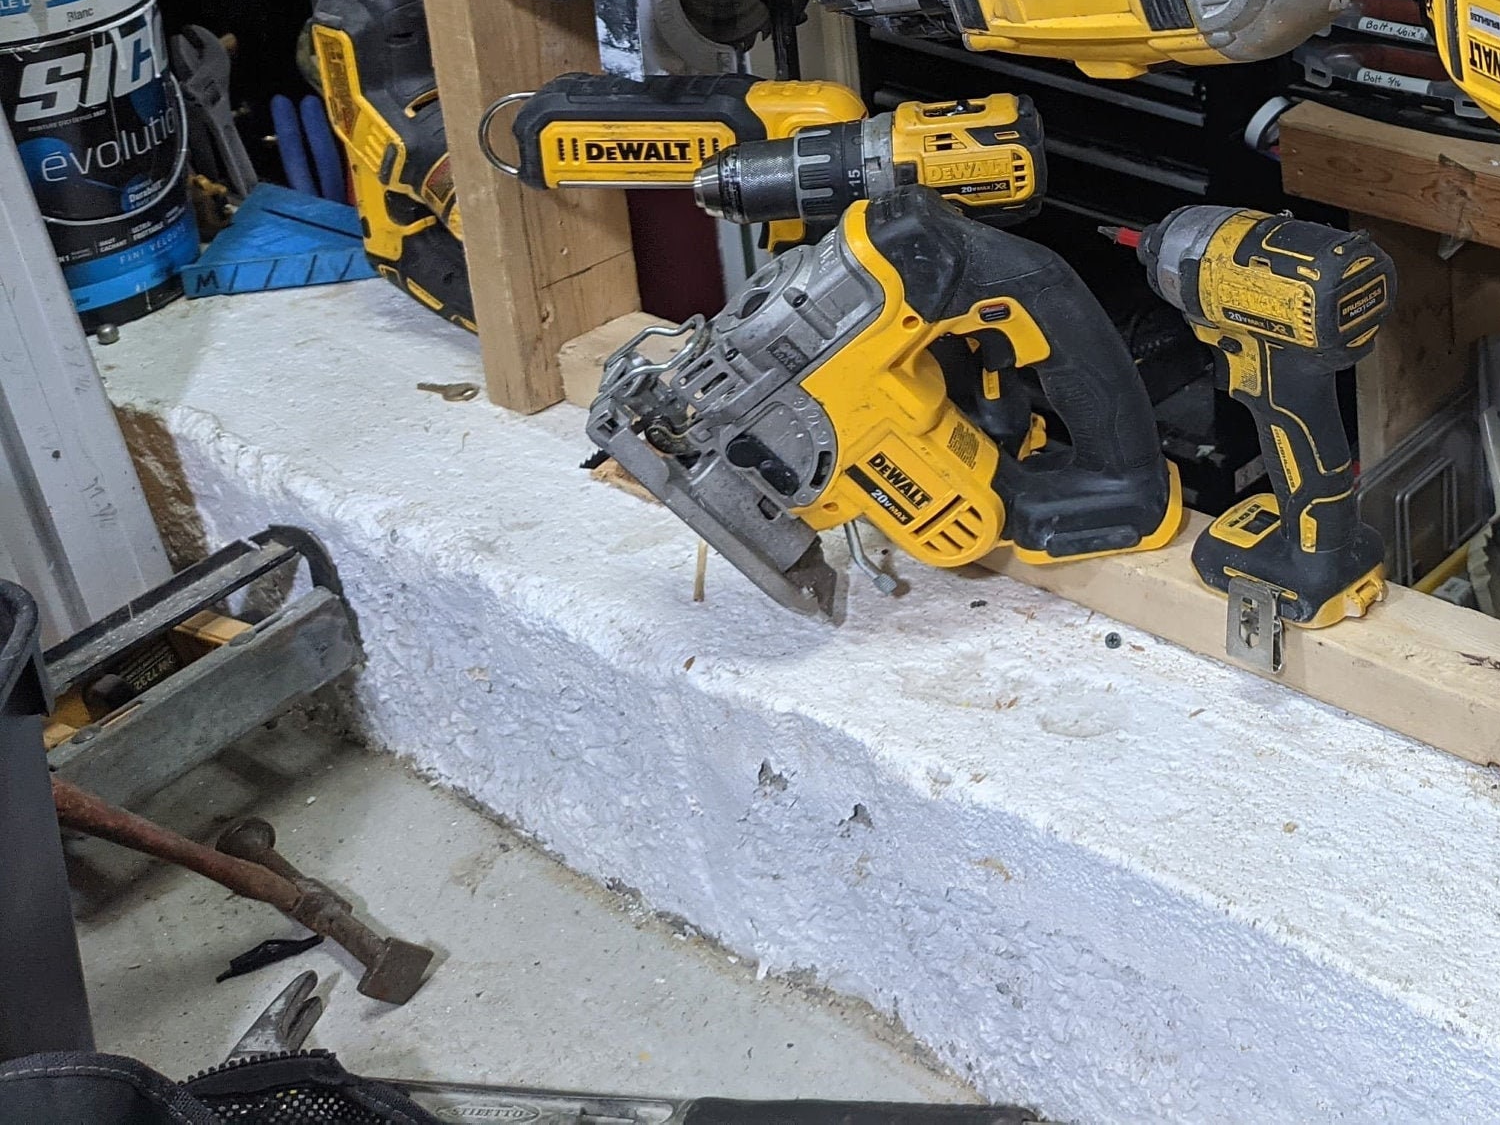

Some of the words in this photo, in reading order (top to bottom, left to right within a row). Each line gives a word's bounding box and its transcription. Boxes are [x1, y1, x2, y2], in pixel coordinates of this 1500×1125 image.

[41, 105, 178, 183] évolutio
[1342, 287, 1382, 316] BRUSHLESS
[1349, 298, 1377, 318] MOTOR
